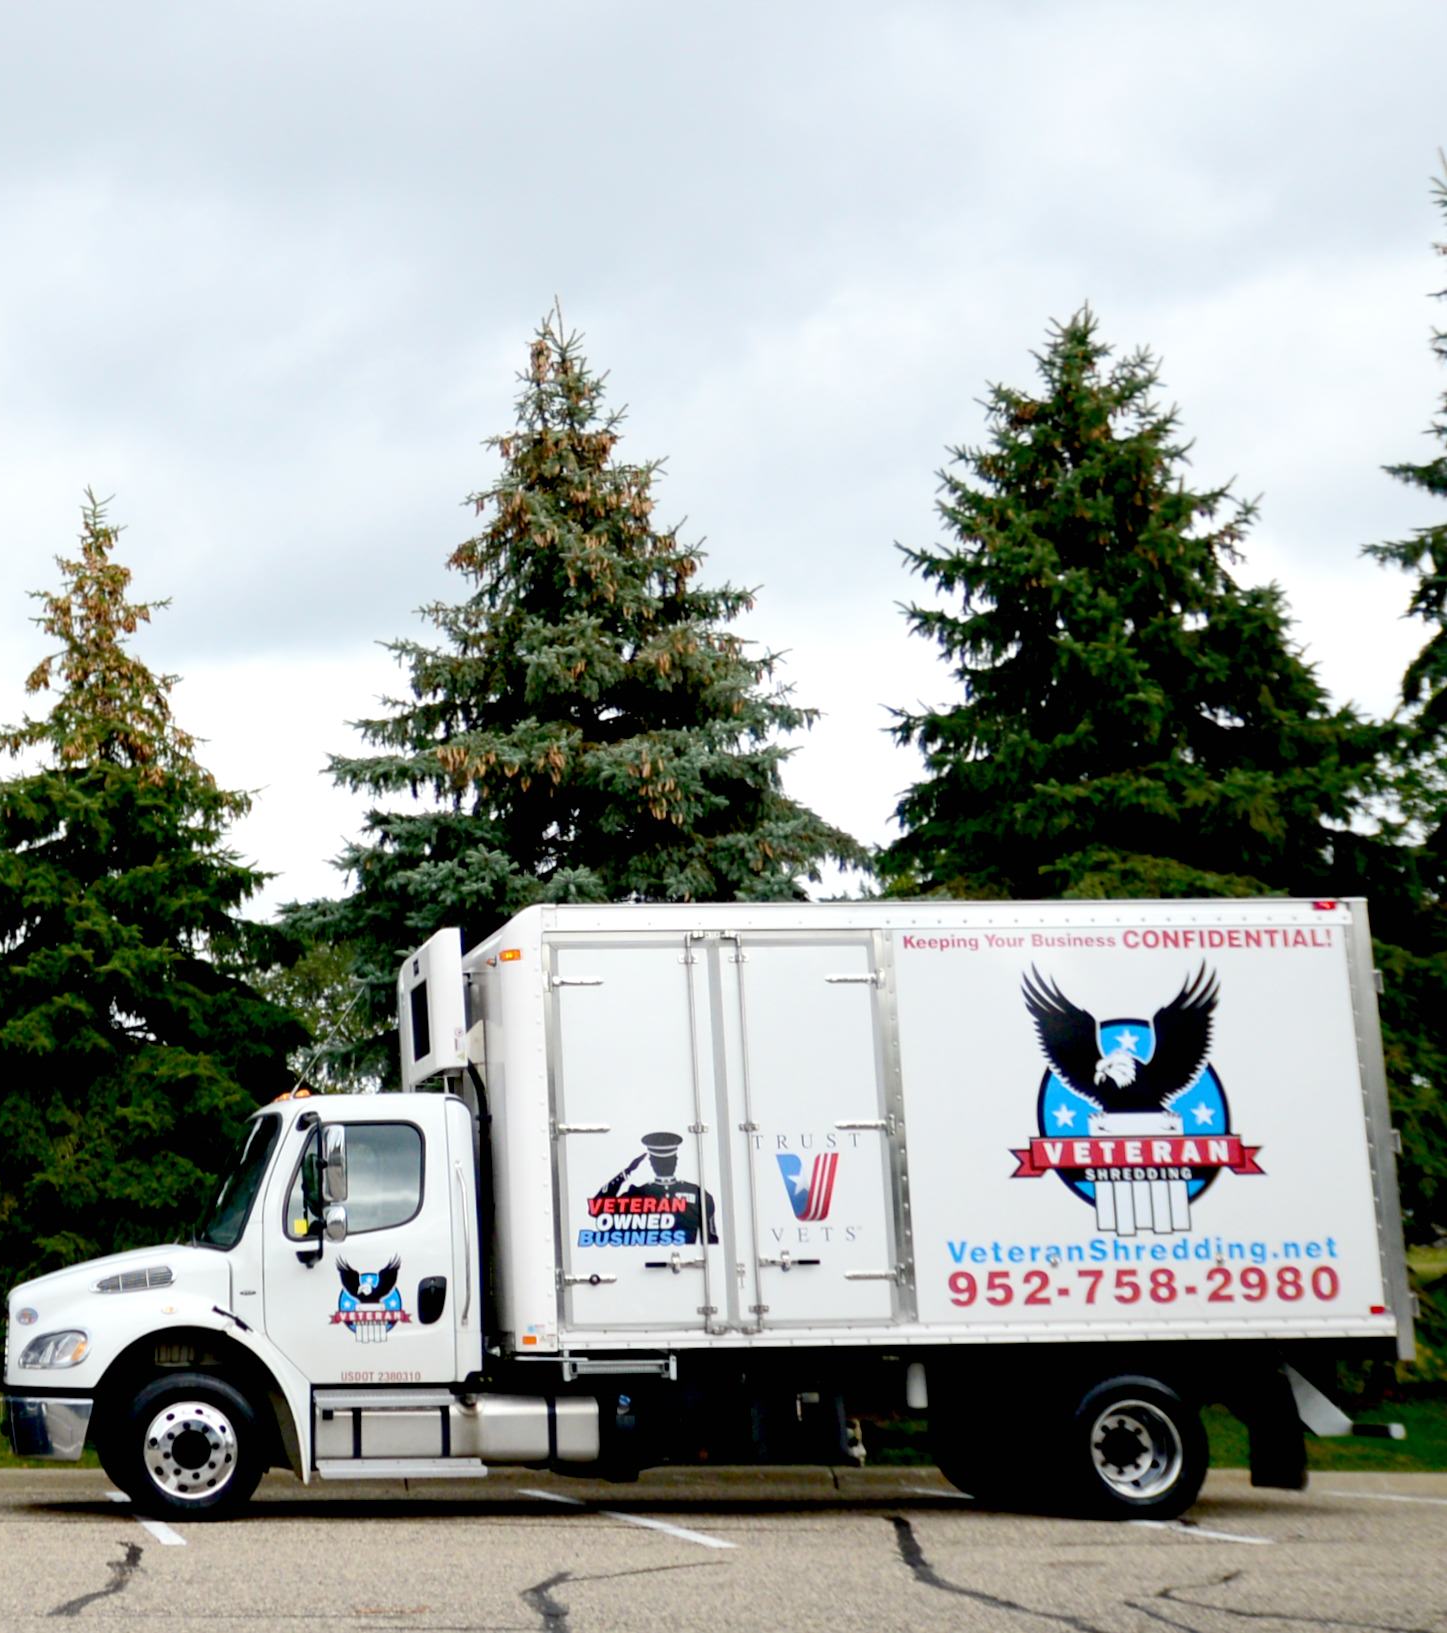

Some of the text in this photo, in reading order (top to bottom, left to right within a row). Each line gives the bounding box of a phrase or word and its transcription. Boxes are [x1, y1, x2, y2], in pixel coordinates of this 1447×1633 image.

[902, 929, 1332, 952] Keeping Your Business CONFIDENTIAL!
[753, 1133, 860, 1149] TRUST
[1043, 1140, 1229, 1165] VETERAN
[1084, 1167, 1192, 1181] SHREDDING
[587, 1197, 686, 1216] VETERAN
[596, 1213, 675, 1231] OWNED
[578, 1230, 686, 1247] BUSINESS
[947, 1236, 1338, 1264] VeteranShredding.net
[948, 1265, 1340, 1307] 952-758-2980
[339, 1311, 403, 1322] VETERAN
[341, 1371, 421, 1382] USDOT 2380310
